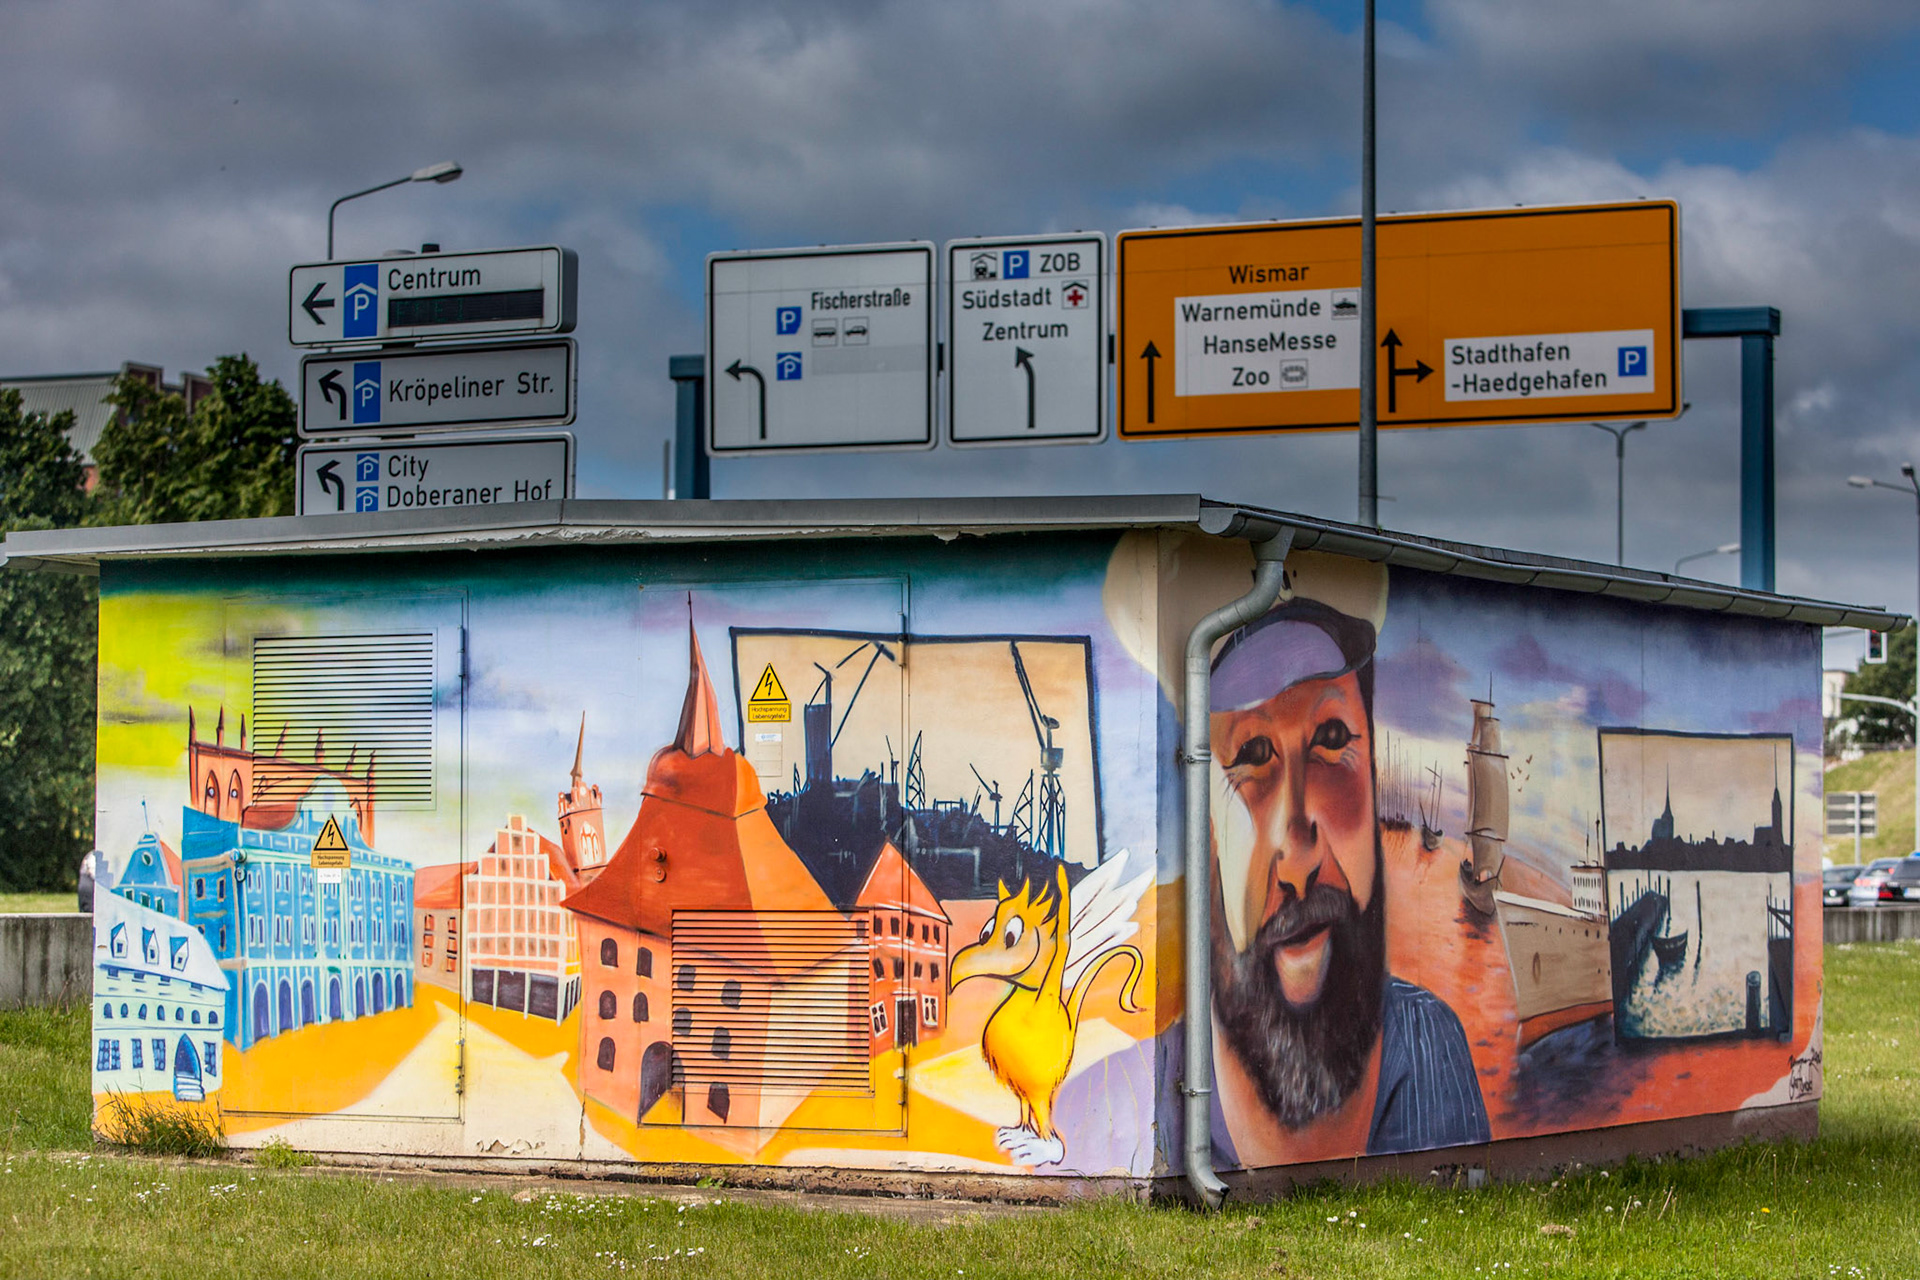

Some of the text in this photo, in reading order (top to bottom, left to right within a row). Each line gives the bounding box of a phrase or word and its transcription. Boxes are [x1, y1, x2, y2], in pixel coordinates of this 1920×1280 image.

[1008, 253, 1081, 275] P ZOB
[1229, 265, 1310, 284] Wismar
[354, 267, 481, 321] P Centrum
[811, 288, 911, 310] Fischerstraße
[962, 287, 1052, 310] Südstadt
[781, 311, 796, 330] P
[1181, 298, 1322, 323] Warnemünde
[982, 321, 1069, 342] Zentrum
[1203, 331, 1338, 355] HanseMesse
[1452, 341, 1640, 373] Stadthafen P
[784, 361, 796, 378] P
[1232, 367, 1270, 387] Zoo
[362, 371, 554, 408] P Kröpeliner Str.
[1451, 370, 1608, 396] -Haedgehafen
[363, 455, 430, 482] P City
[363, 479, 552, 512] P Doberaner Hof
